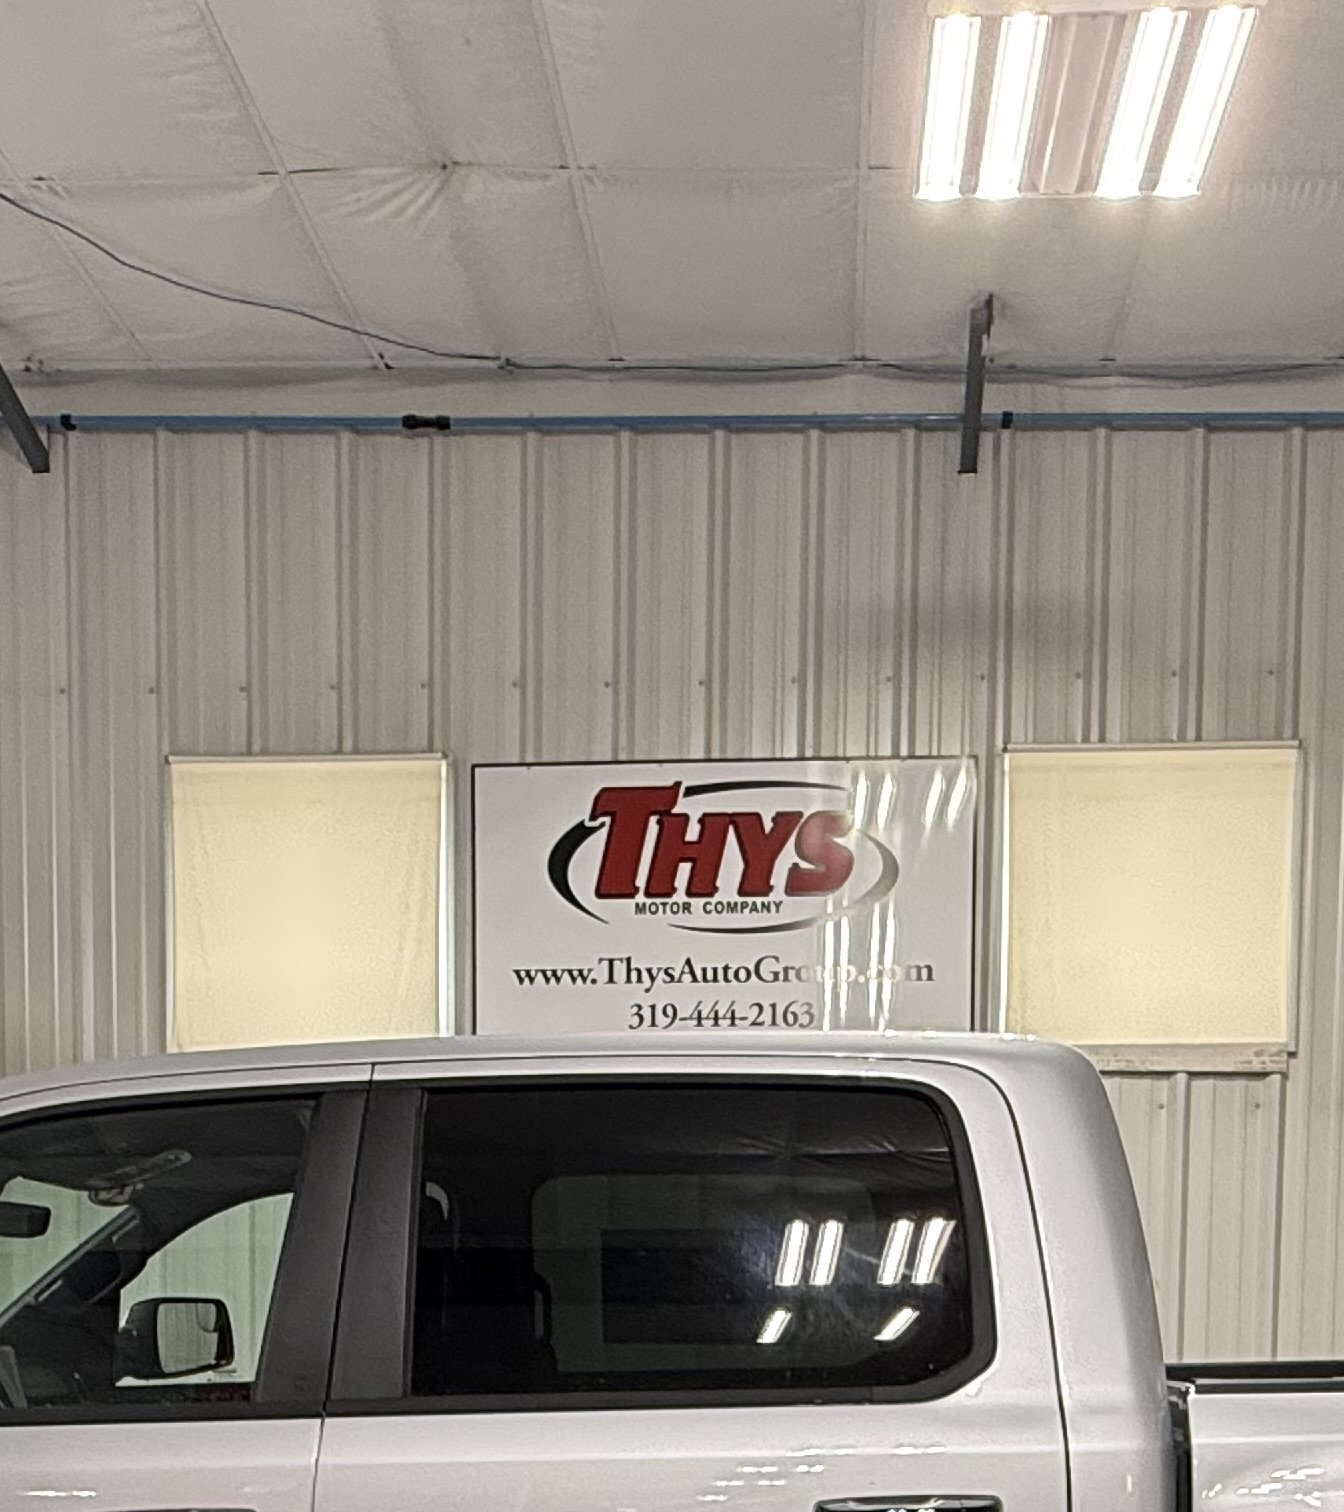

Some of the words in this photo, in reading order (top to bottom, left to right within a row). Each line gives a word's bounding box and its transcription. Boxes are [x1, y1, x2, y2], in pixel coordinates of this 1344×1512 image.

[593, 781, 855, 899] THYS
[635, 901, 693, 916] MOTOR
[703, 900, 784, 915] COMPANY
[628, 1000, 816, 1031] 319-444-2163
